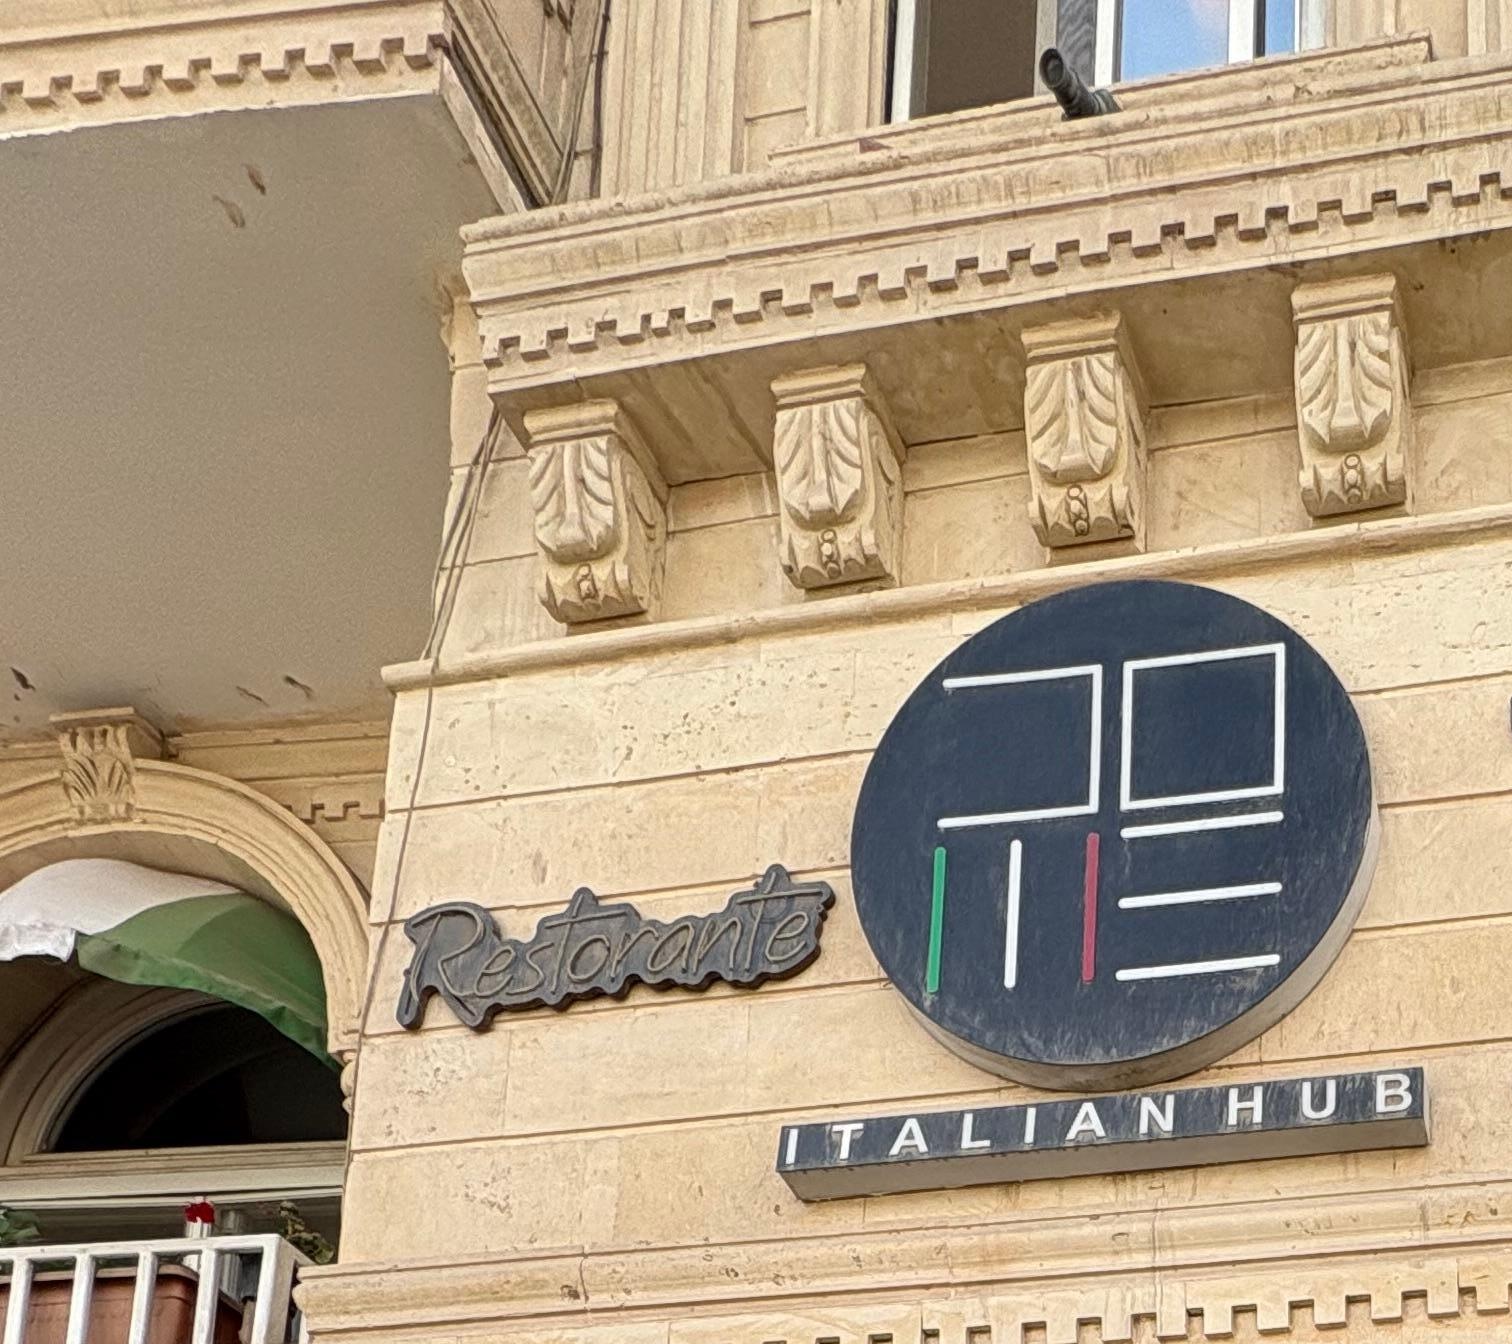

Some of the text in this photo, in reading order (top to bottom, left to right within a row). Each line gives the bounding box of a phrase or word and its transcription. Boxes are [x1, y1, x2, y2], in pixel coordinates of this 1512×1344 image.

[403, 871, 827, 1017] Restorante
[784, 1072, 1414, 1166] ITALIAN HUB
